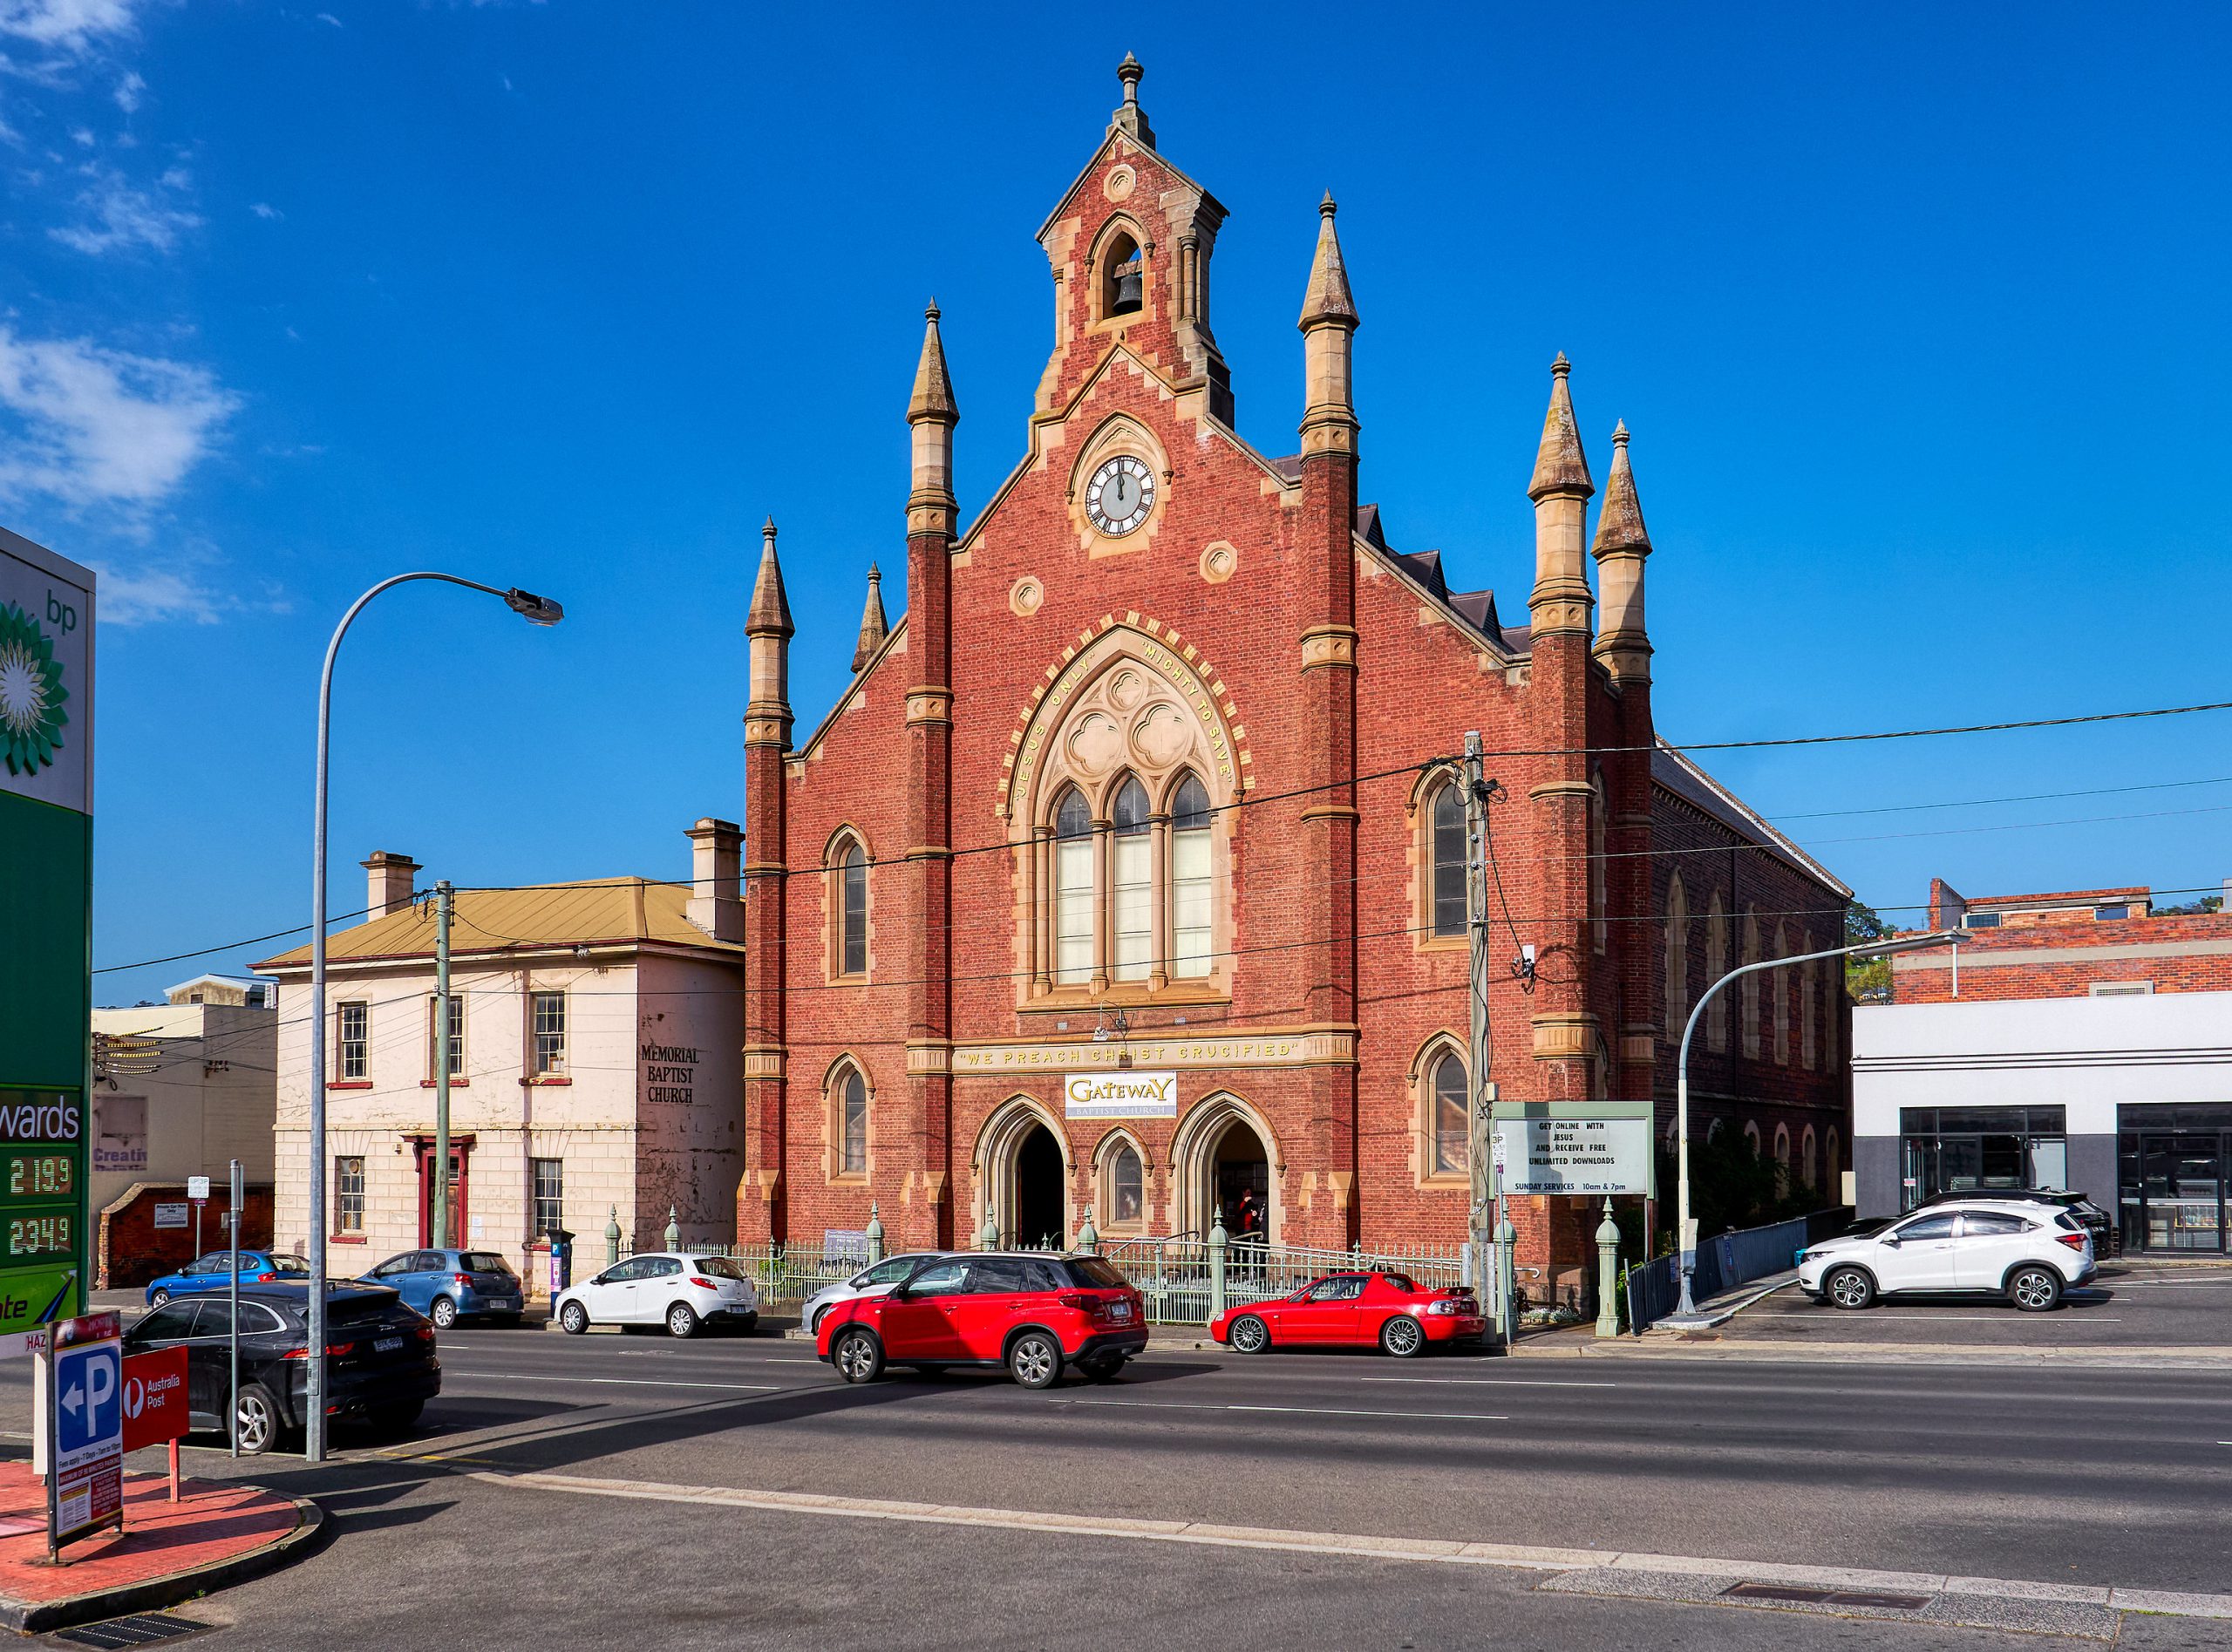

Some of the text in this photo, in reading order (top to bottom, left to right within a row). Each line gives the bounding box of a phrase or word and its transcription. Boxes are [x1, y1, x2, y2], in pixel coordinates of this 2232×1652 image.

[46, 589, 77, 636] bp
[1197, 699, 1213, 721] TO
[641, 1044, 700, 1064] MEMORIAL
[1004, 1050, 1080, 1064] PREACH
[1092, 1048, 1165, 1062] CHRIST
[647, 1065, 694, 1084] BAPTIST
[648, 1086, 693, 1104] CHURCH
[1539, 1122, 1552, 1131] GET
[1514, 1182, 1541, 1191] SUNDAY
[1610, 1182, 1626, 1192] 7pm
[0, 1295, 28, 1320] te
[147, 1374, 180, 1393] Australia
[86, 1354, 115, 1438] P
[147, 1393, 165, 1409] Post
